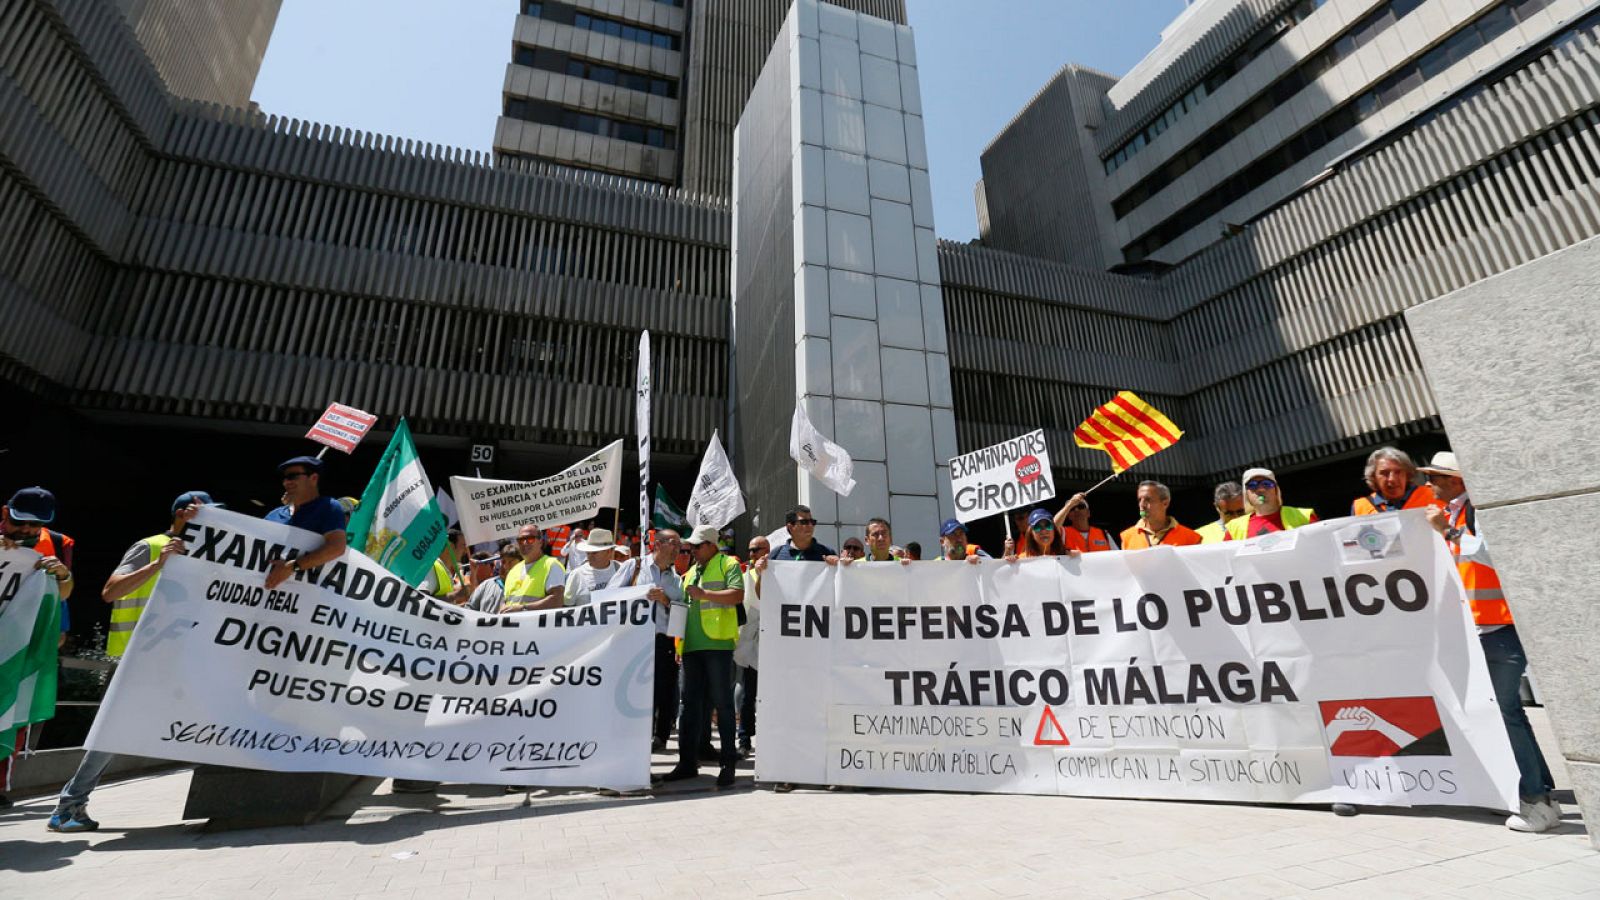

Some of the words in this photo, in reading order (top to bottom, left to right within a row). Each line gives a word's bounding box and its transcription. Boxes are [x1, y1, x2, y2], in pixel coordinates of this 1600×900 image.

[472, 447, 492, 460] 50
[470, 491, 486, 501] LOS
[567, 468, 578, 479] DE
[580, 466, 591, 476] LA
[592, 462, 608, 473] DGT
[480, 502, 491, 512] DE
[492, 494, 532, 508] MURCIA
[532, 492, 538, 500] Y
[540, 475, 602, 498] CARTAGENA
[480, 514, 490, 523] EN
[491, 508, 523, 522] HUELGA
[524, 503, 541, 514] POR
[543, 500, 555, 510] LA
[496, 522, 511, 532] DEL
[547, 511, 557, 521] DE
[560, 501, 597, 518] TRABAJO
[206, 579, 263, 606] CIUDAD
[264, 588, 300, 614] REAL
[781, 604, 830, 639] EN
[844, 604, 1031, 640] DEFENSA
[1042, 599, 1100, 636] DE
[1112, 592, 1169, 631] LO
[1183, 569, 1430, 628] PÚBLICO
[310, 604, 348, 629] EN
[352, 616, 448, 651] HUELGA
[456, 639, 504, 656] POR
[512, 640, 540, 656] LA
[214, 617, 499, 686] DIGNIFICACIÓN
[508, 664, 545, 686] DE
[550, 665, 603, 687] SUS
[248, 669, 386, 708] PUESTOS
[393, 691, 433, 714] DE
[441, 695, 557, 719] TRABAJO
[885, 661, 1070, 706] TRÁFICO
[1083, 657, 1300, 706] MÁLAGA
[160, 720, 302, 754] SEGUIMOS
[302, 736, 445, 760] APOYANDO
[445, 741, 482, 762] LO
[487, 735, 598, 764] PÚBLICO
[853, 714, 989, 737] EXAMINADORES
[999, 716, 1023, 738] EN
[1078, 715, 1105, 740] DE
[1108, 707, 1227, 740] EXTINCIÓN
[879, 751, 890, 770] Y
[893, 746, 946, 773] FUNCIÓN
[951, 748, 1017, 776] PÚBLICA
[1058, 756, 1149, 780] COMPLICAN
[1157, 757, 1182, 782] LA
